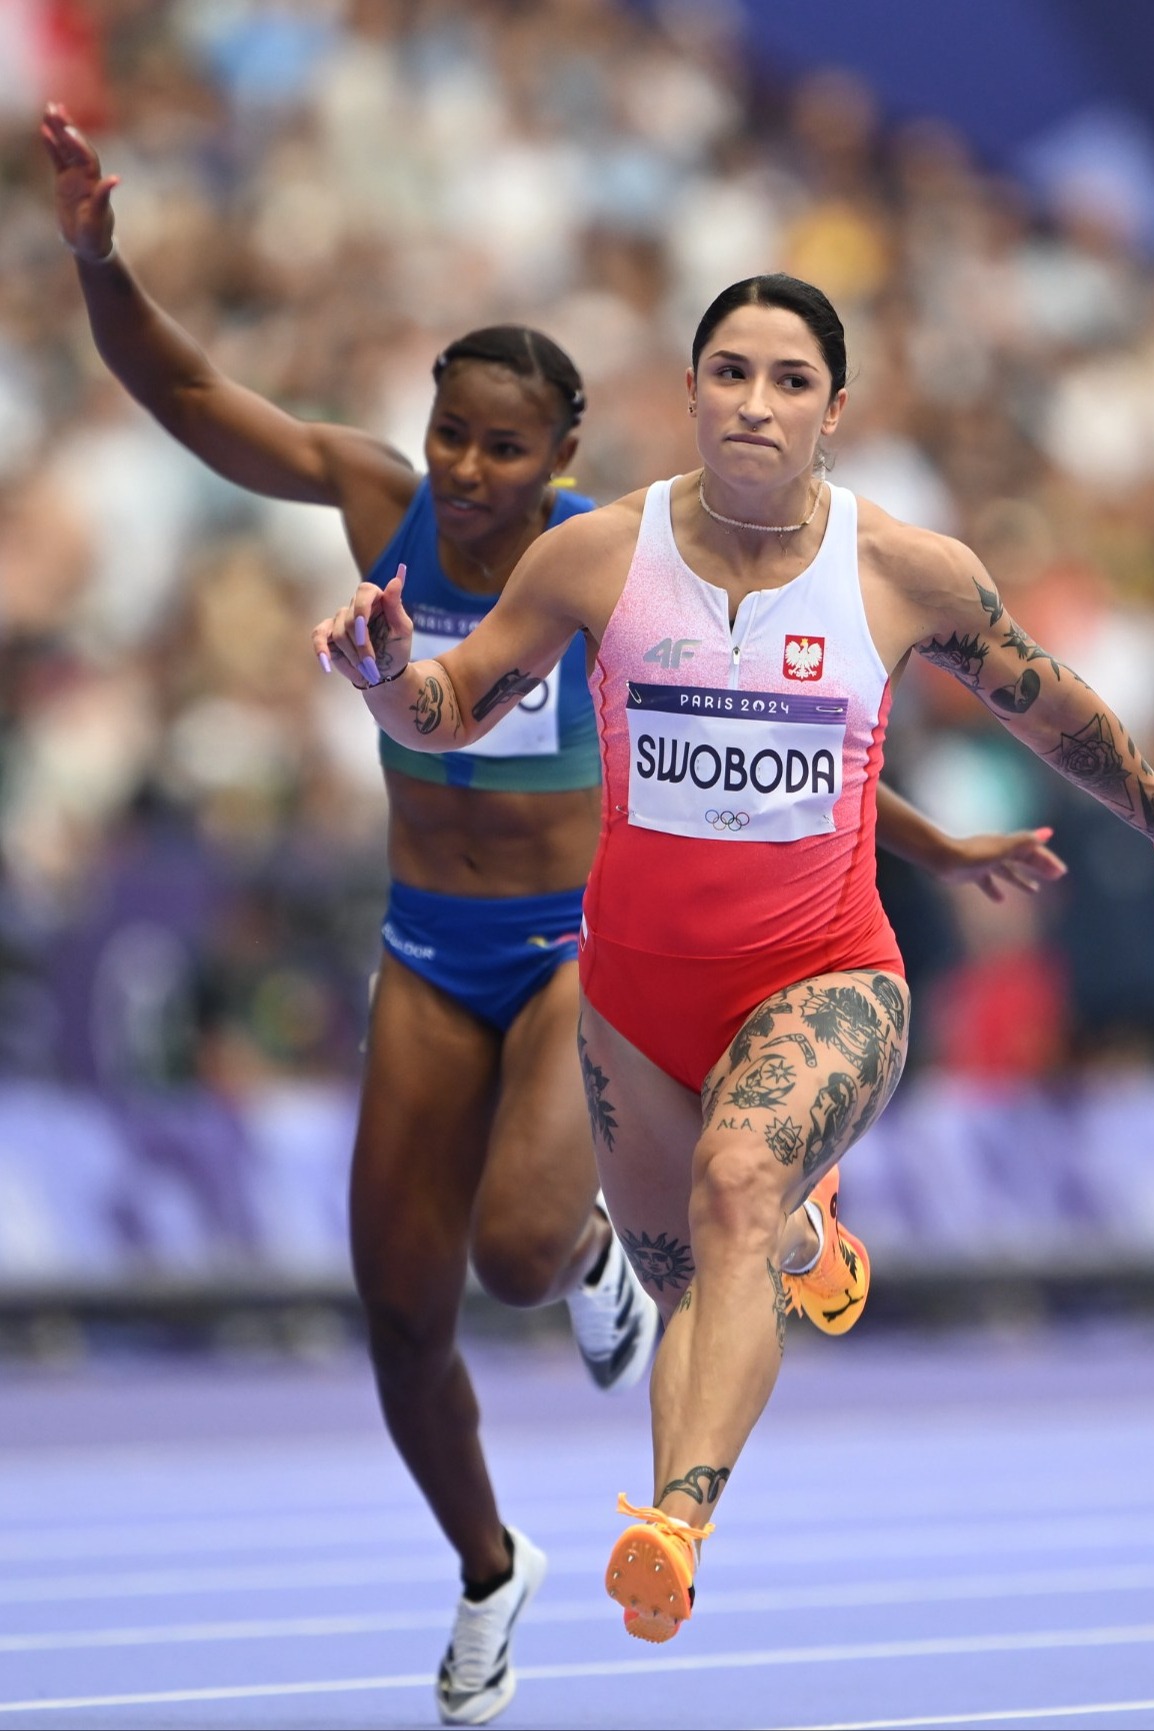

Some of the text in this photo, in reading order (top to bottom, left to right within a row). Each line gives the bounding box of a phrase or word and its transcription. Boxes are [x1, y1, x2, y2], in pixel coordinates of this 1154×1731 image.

[642, 637, 703, 669] 4F
[740, 699, 790, 714] 2024
[636, 734, 836, 795] SWOBODA
